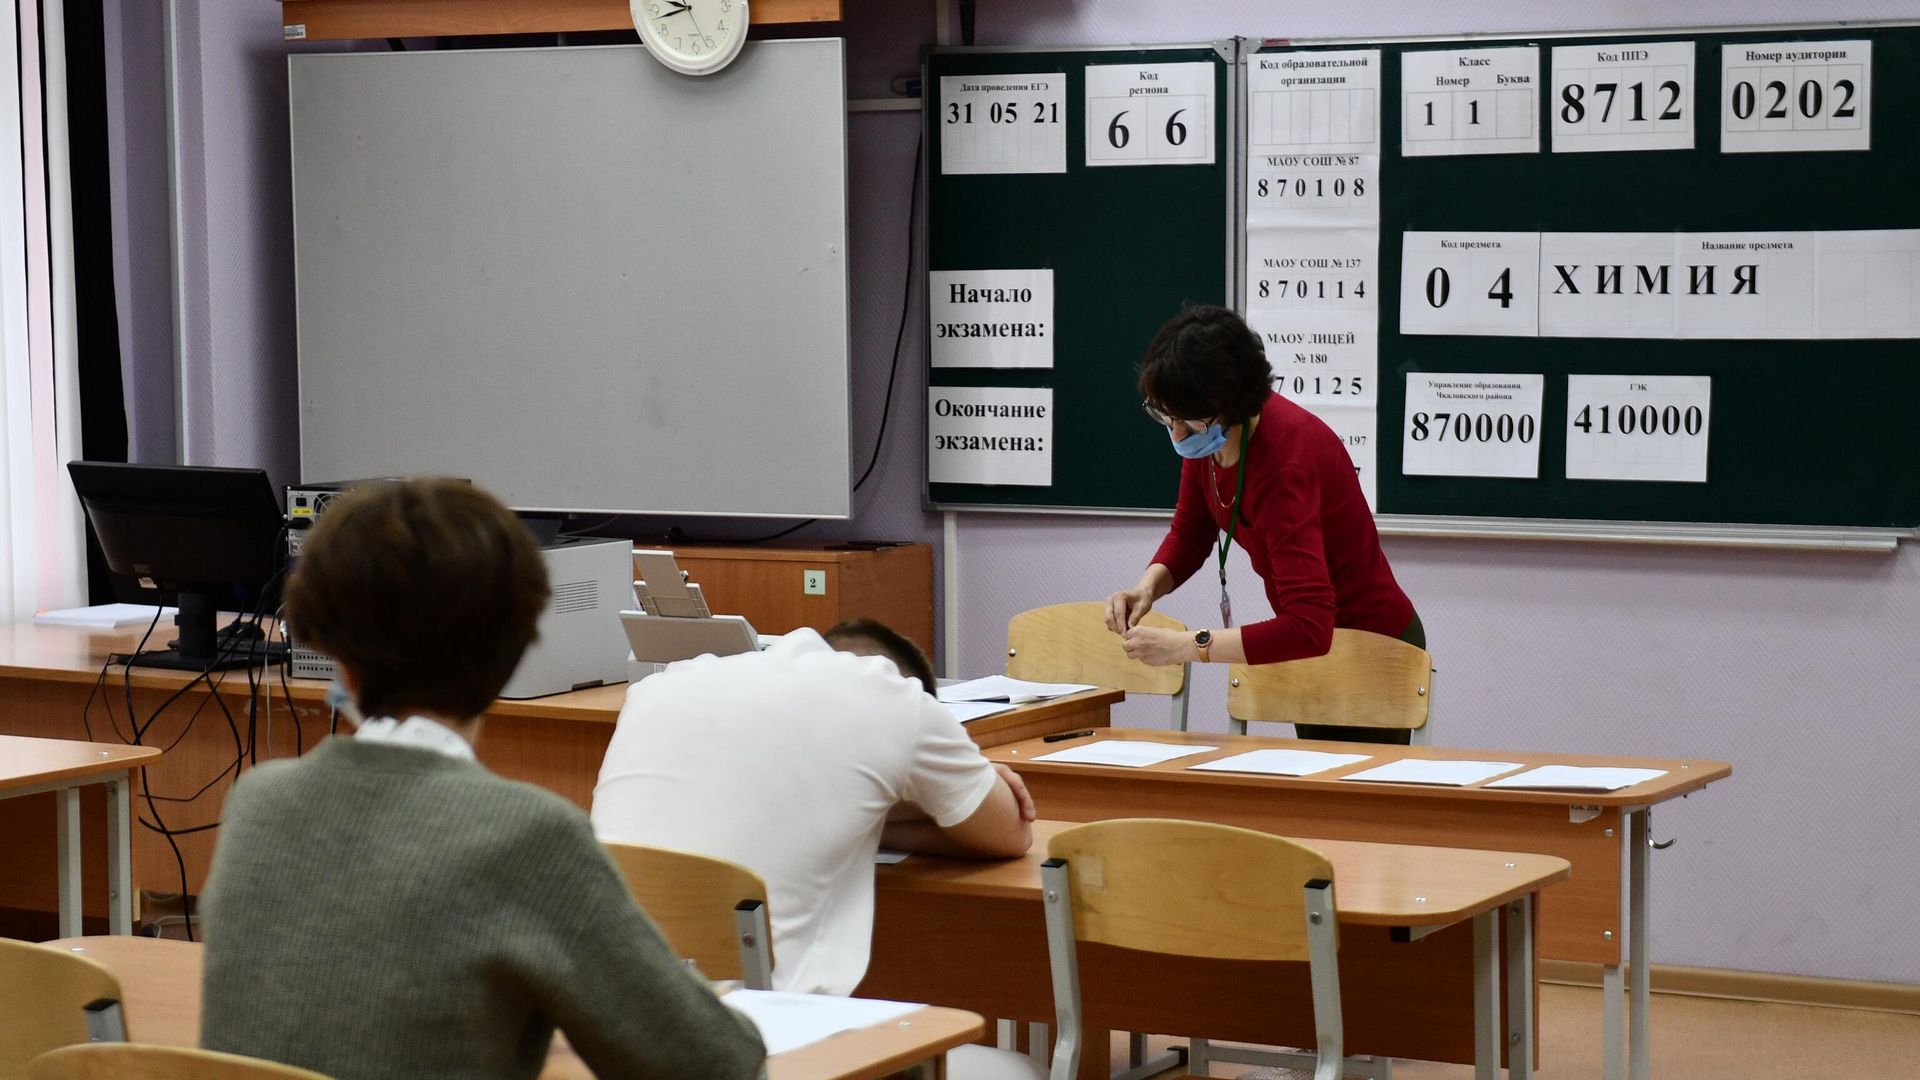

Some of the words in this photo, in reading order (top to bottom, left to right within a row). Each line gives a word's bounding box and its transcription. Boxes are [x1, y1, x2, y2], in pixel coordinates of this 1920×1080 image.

[1458, 56, 1491, 67] Класс
[1597, 51, 1618, 62] Код
[1621, 50, 1649, 61] ППЭ
[1745, 50, 1783, 63] Номер
[1785, 50, 1847, 63] аудитории
[1260, 59, 1279, 70] Код
[1281, 57, 1368, 71] образовательной
[1139, 70, 1159, 82] Код
[1280, 76, 1346, 88] организации
[1436, 76, 1470, 87] Номер
[1496, 74, 1531, 86] Буква
[959, 82, 981, 93] Дата
[981, 82, 1028, 93] проведения
[1030, 82, 1049, 91] ЕГЭ
[1129, 86, 1169, 96] региона
[1560, 80, 1682, 124] 8712
[1731, 79, 1856, 120] 0202
[947, 102, 973, 124] 31
[990, 101, 1017, 124] 05
[1033, 101, 1058, 123] 21
[1267, 156, 1300, 167] МАОУ
[1303, 156, 1332, 167] СОШ
[1334, 156, 1347, 166] №
[1348, 156, 1360, 166] 87
[1440, 239, 1457, 249] Код
[1459, 240, 1501, 250] предмета
[1701, 240, 1746, 250] Название
[1748, 241, 1794, 252] предмета
[1263, 258, 1296, 268] МАОУ
[1299, 258, 1329, 269] СОШ
[1330, 258, 1343, 268] №
[1345, 258, 1361, 268] 137
[1552, 264, 1760, 295] ХИМИЯ
[949, 283, 1032, 304] Начало
[936, 322, 1044, 338] экзамена:
[1267, 333, 1304, 344] МАОУ
[1308, 331, 1355, 346] ЛИЦЕЙ
[1293, 353, 1306, 364] №
[1309, 353, 1328, 364] 180
[1274, 376, 1362, 395] 70125
[1629, 383, 1648, 392] ГЭК
[1485, 392, 1513, 402] района
[934, 398, 1046, 418] Окончание
[1573, 403, 1703, 436] 410000
[1411, 411, 1535, 444] 870000
[935, 434, 1044, 452] экзамена:
[1349, 435, 1367, 446] 197
[810, 577, 816, 588] 2
